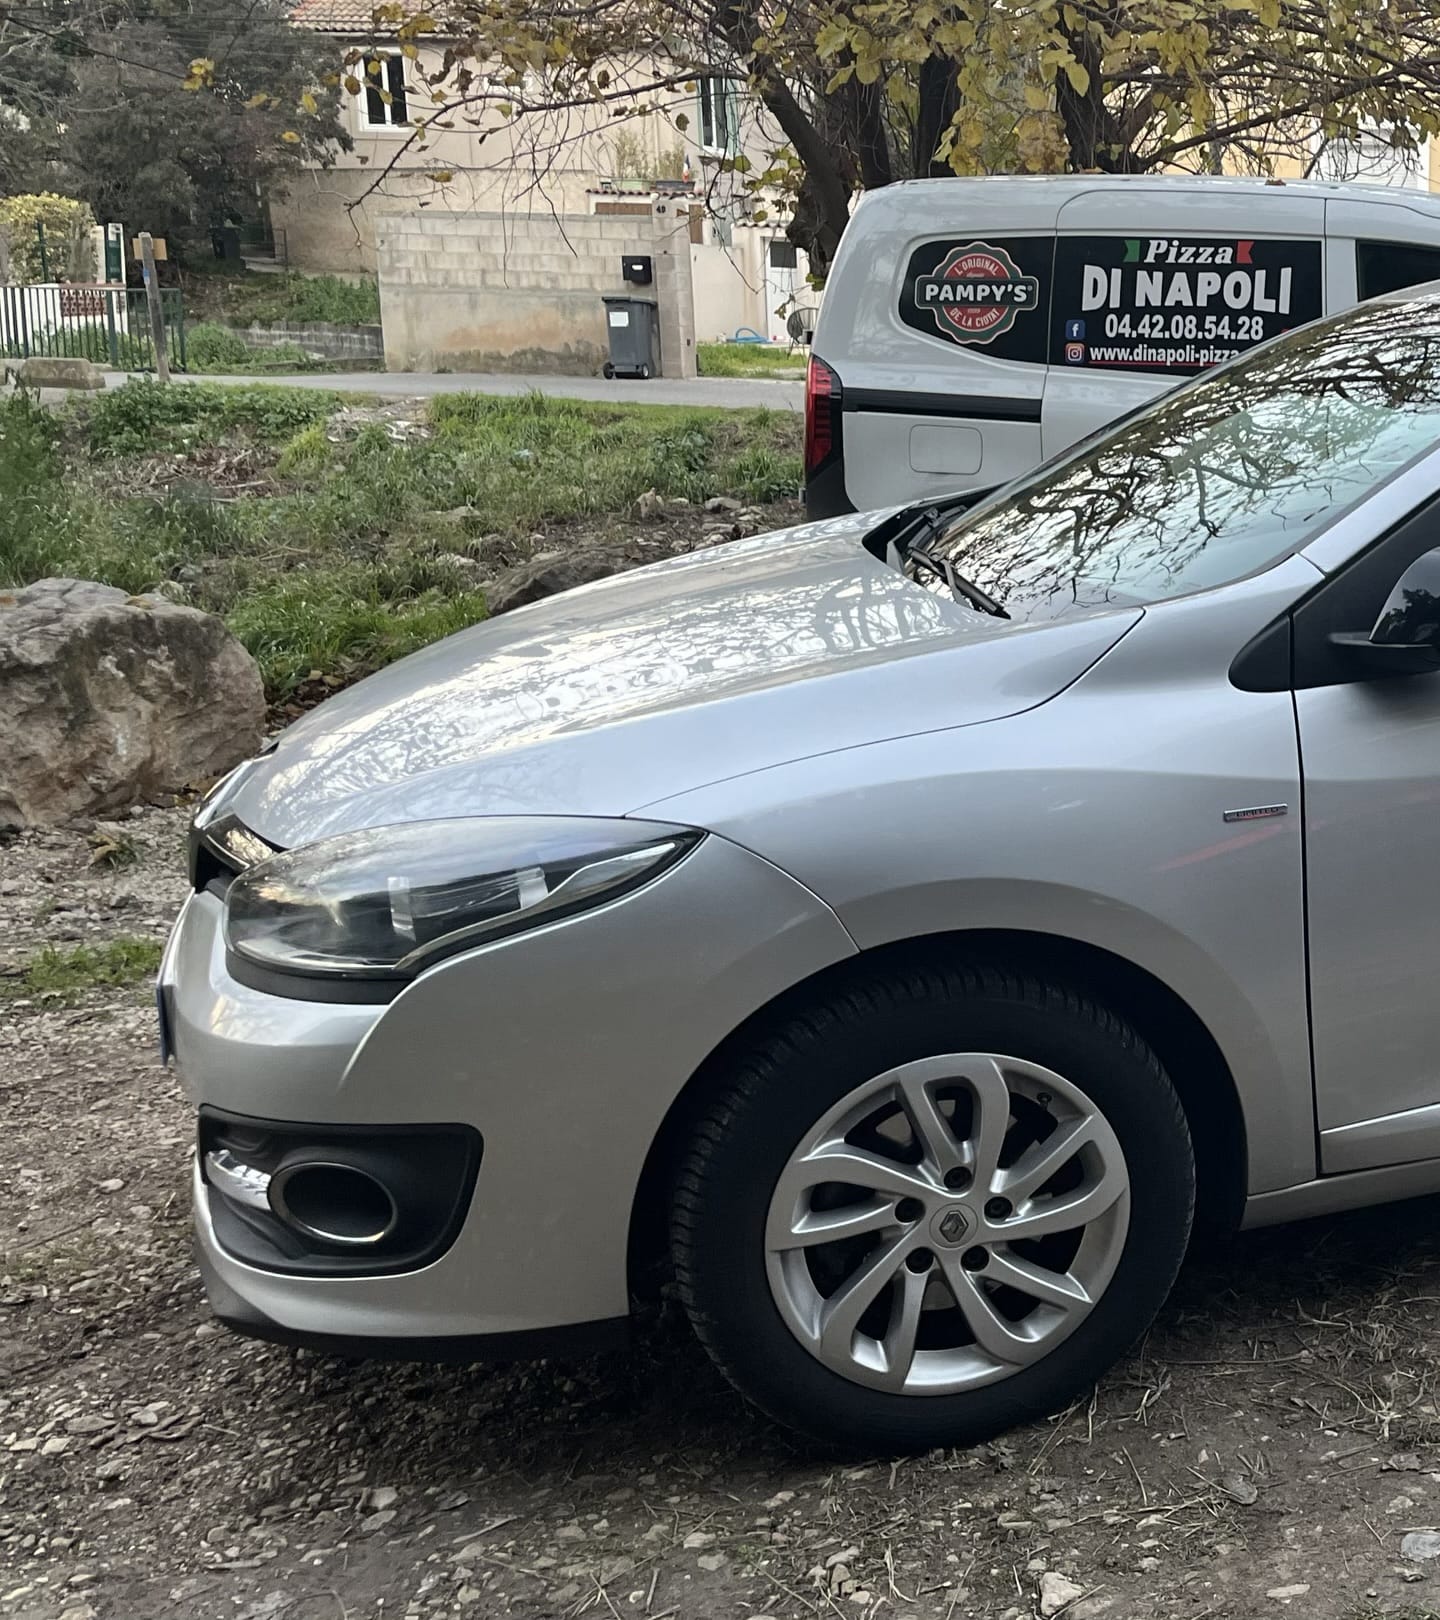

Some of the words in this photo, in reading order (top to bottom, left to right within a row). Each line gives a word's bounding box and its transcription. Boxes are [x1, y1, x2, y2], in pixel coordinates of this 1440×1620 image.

[1143, 239, 1234, 265] Pizza
[953, 257, 1000, 276] L'ORIGINAL
[925, 283, 1028, 303] PAMPY'S
[1081, 263, 1122, 312] DI
[1134, 266, 1293, 315] NAPOLI
[949, 307, 963, 322] DE
[961, 315, 973, 328] LA
[1104, 313, 1264, 341] 04.42.08.54.28
